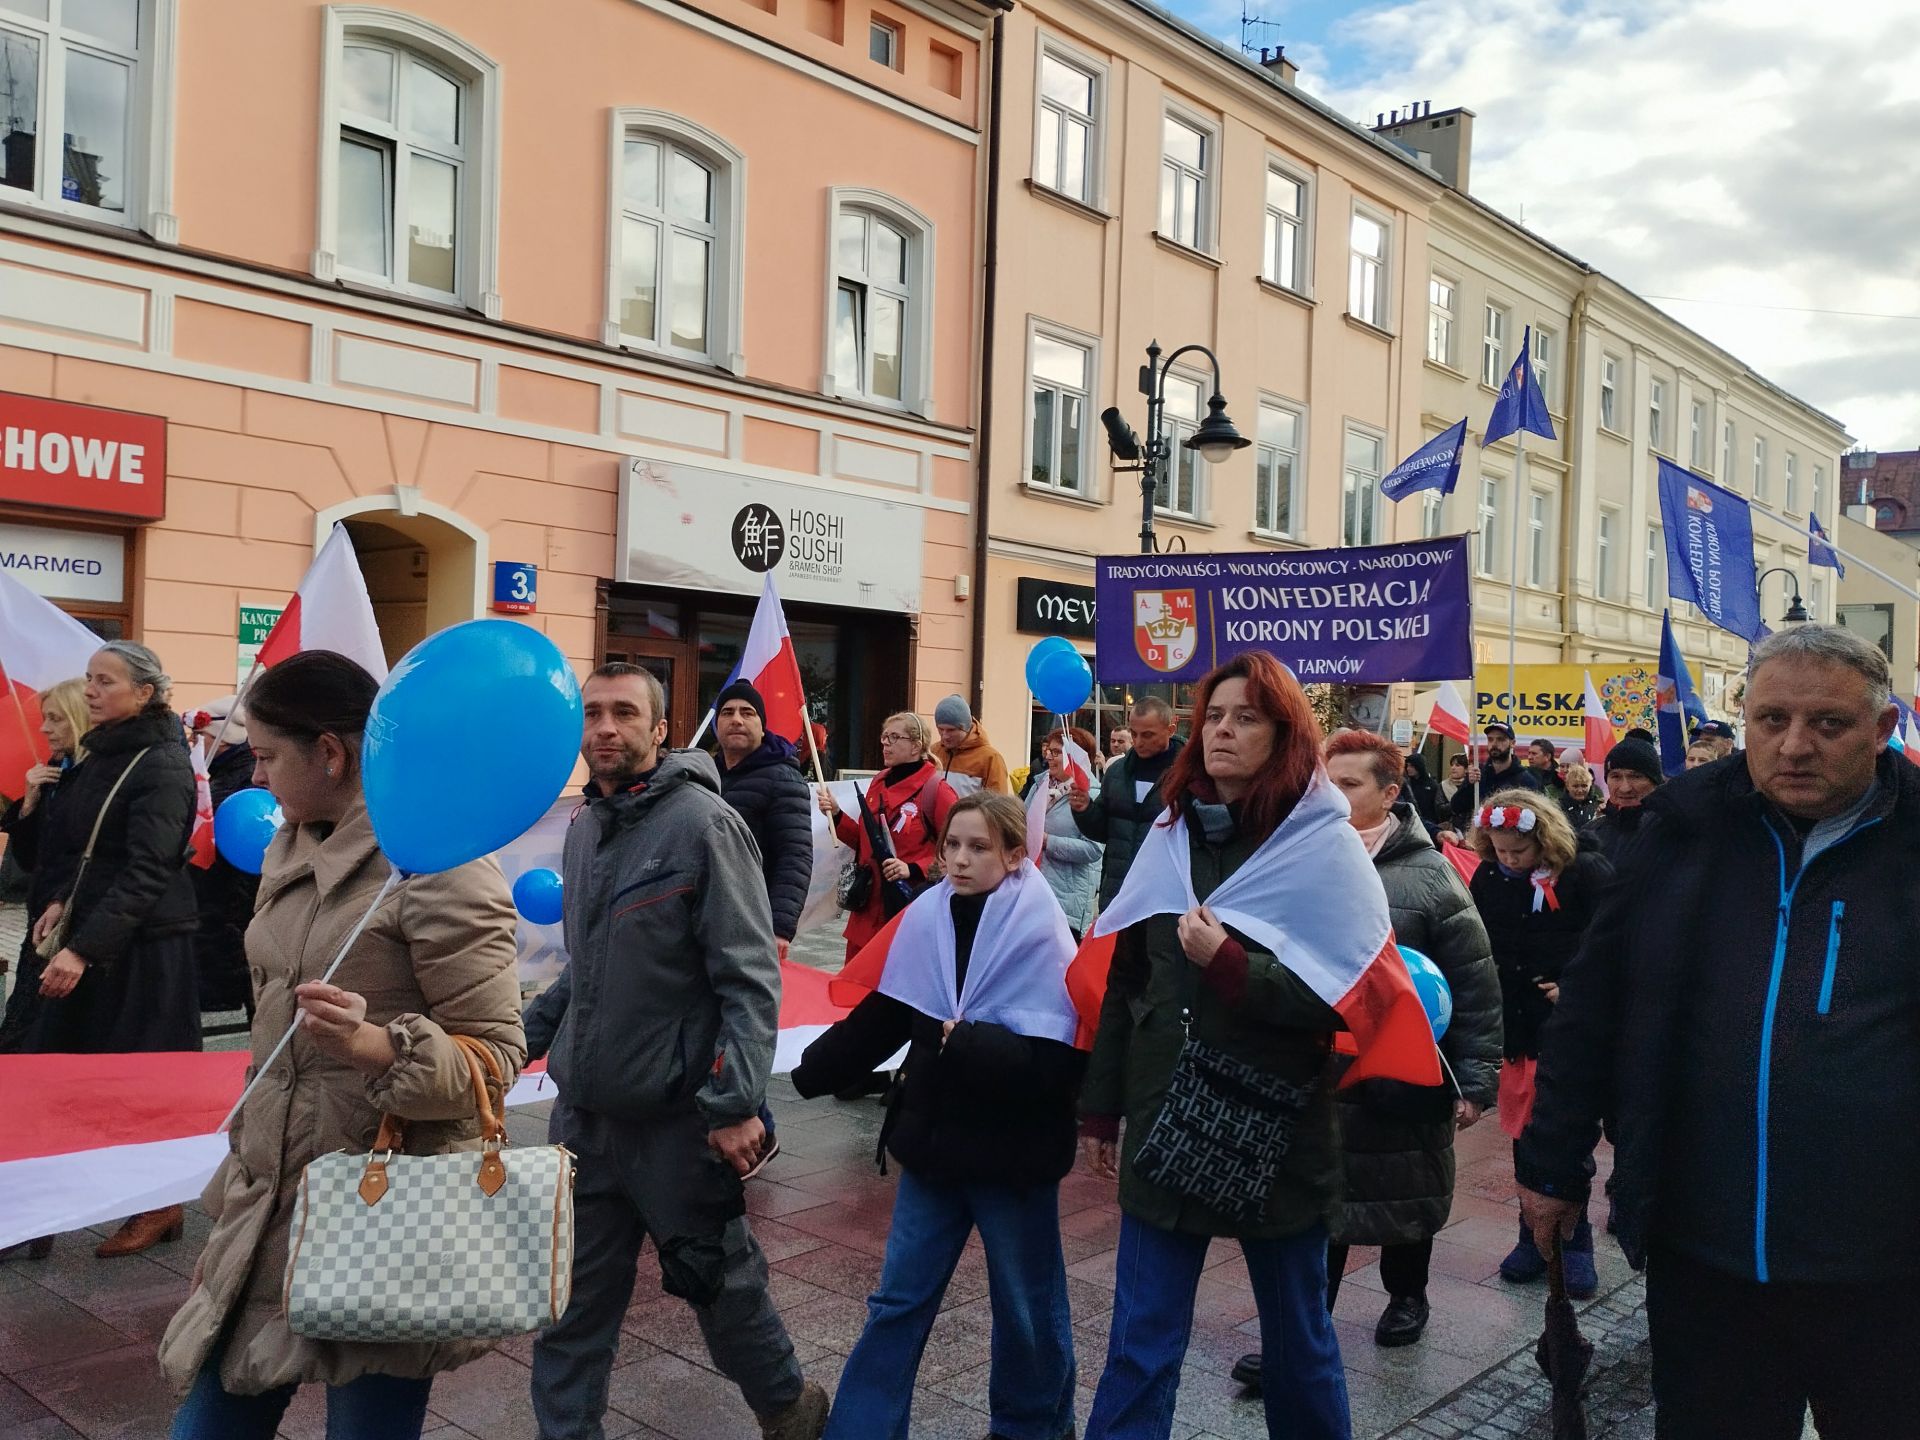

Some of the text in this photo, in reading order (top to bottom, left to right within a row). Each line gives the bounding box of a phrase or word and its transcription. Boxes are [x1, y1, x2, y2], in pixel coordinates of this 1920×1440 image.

[0, 426, 145, 484] HOWE
[790, 509, 843, 539] HOSHI
[790, 535, 843, 565] SUSHI
[789, 560, 842, 576] &RAMEN SHOP
[1107, 562, 1221, 579] TRADYCJONALIŚCI
[1228, 560, 1349, 577] WOLNOŚCIOWCY
[511, 571, 528, 600] 3
[1222, 578, 1431, 610] KONFEDERACJA
[253, 628, 271, 641] PR
[1226, 614, 1430, 643] KORONY POLSKIEJ
[1298, 656, 1365, 675] TARNÓW
[1477, 692, 1586, 711] POLSKA
[1477, 713, 1586, 727] ZA POKOJE
